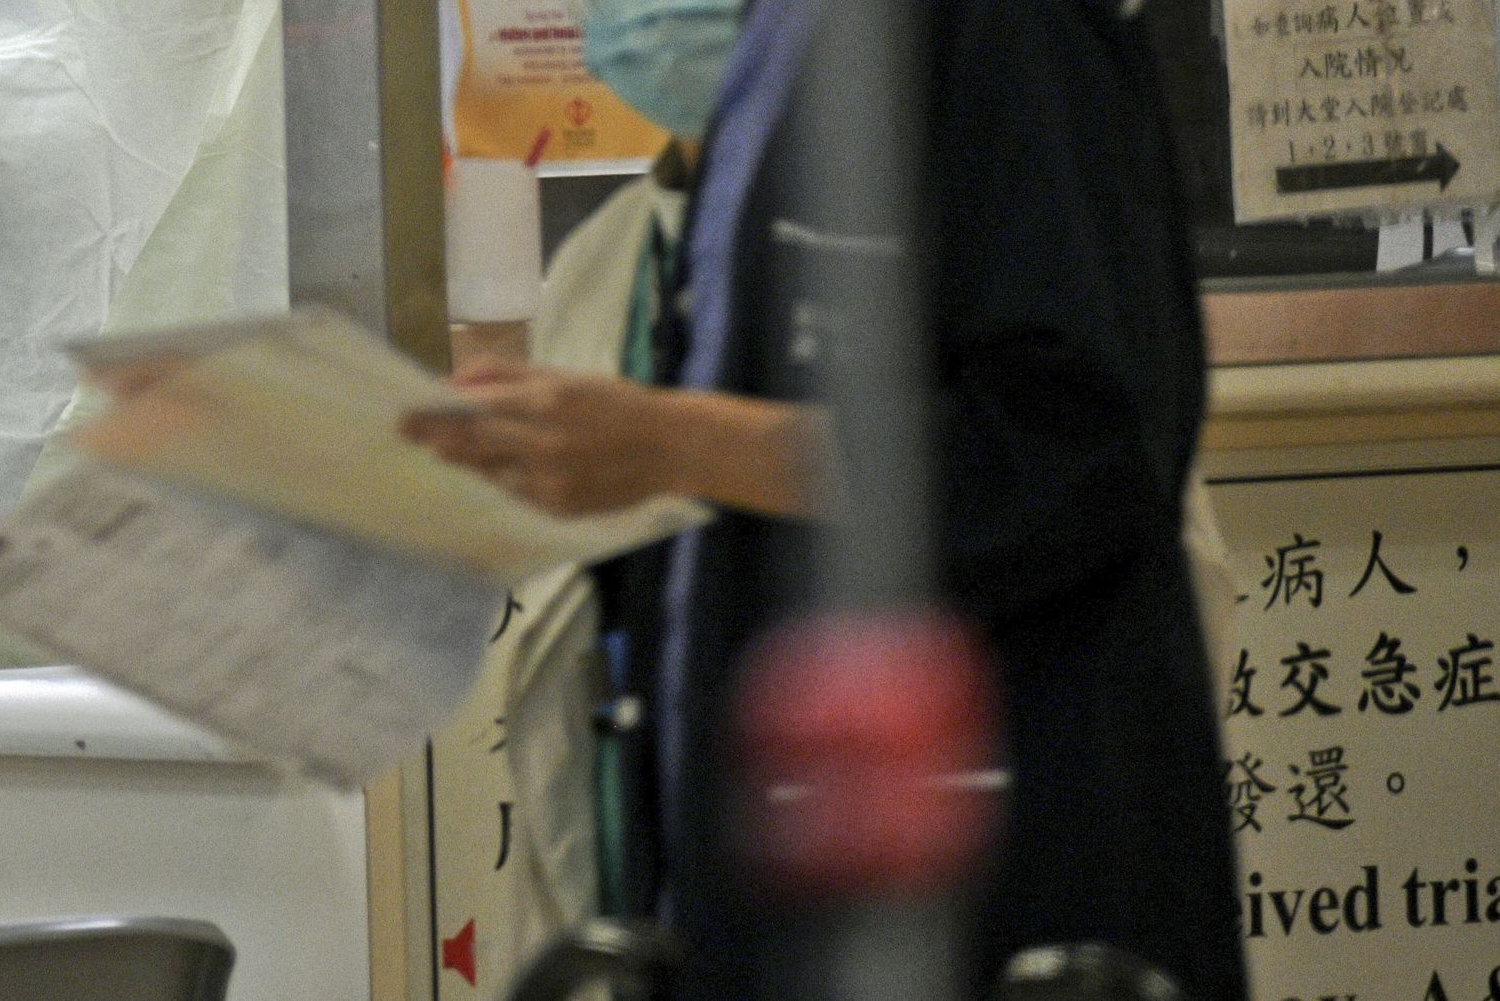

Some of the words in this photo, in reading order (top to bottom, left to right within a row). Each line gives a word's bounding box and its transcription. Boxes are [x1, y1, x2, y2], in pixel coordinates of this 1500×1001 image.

[1300, 46, 1413, 79] 入院情況
[1243, 865, 1383, 938] ived
